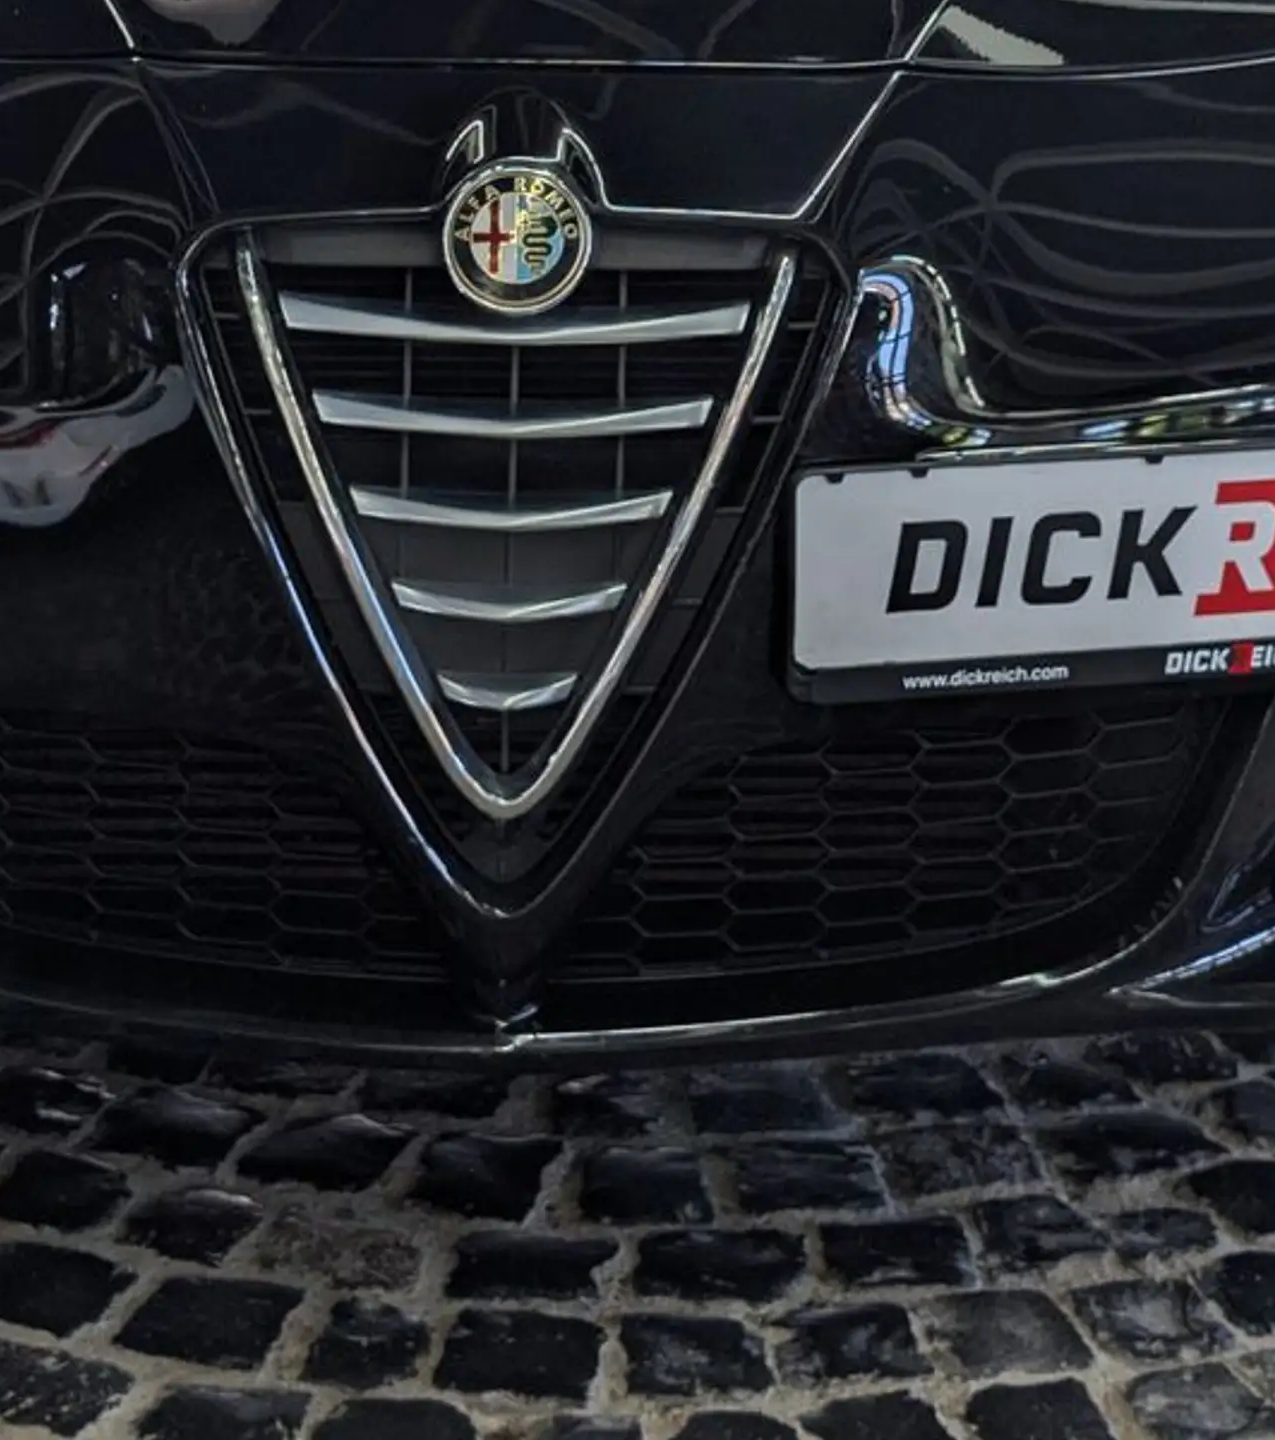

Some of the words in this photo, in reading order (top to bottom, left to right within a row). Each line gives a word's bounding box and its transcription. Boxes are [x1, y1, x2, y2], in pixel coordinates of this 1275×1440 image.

[454, 184, 501, 242] ALFA
[514, 176, 578, 240] ROMEO
[902, 665, 1070, 690] www.dickreich.com
